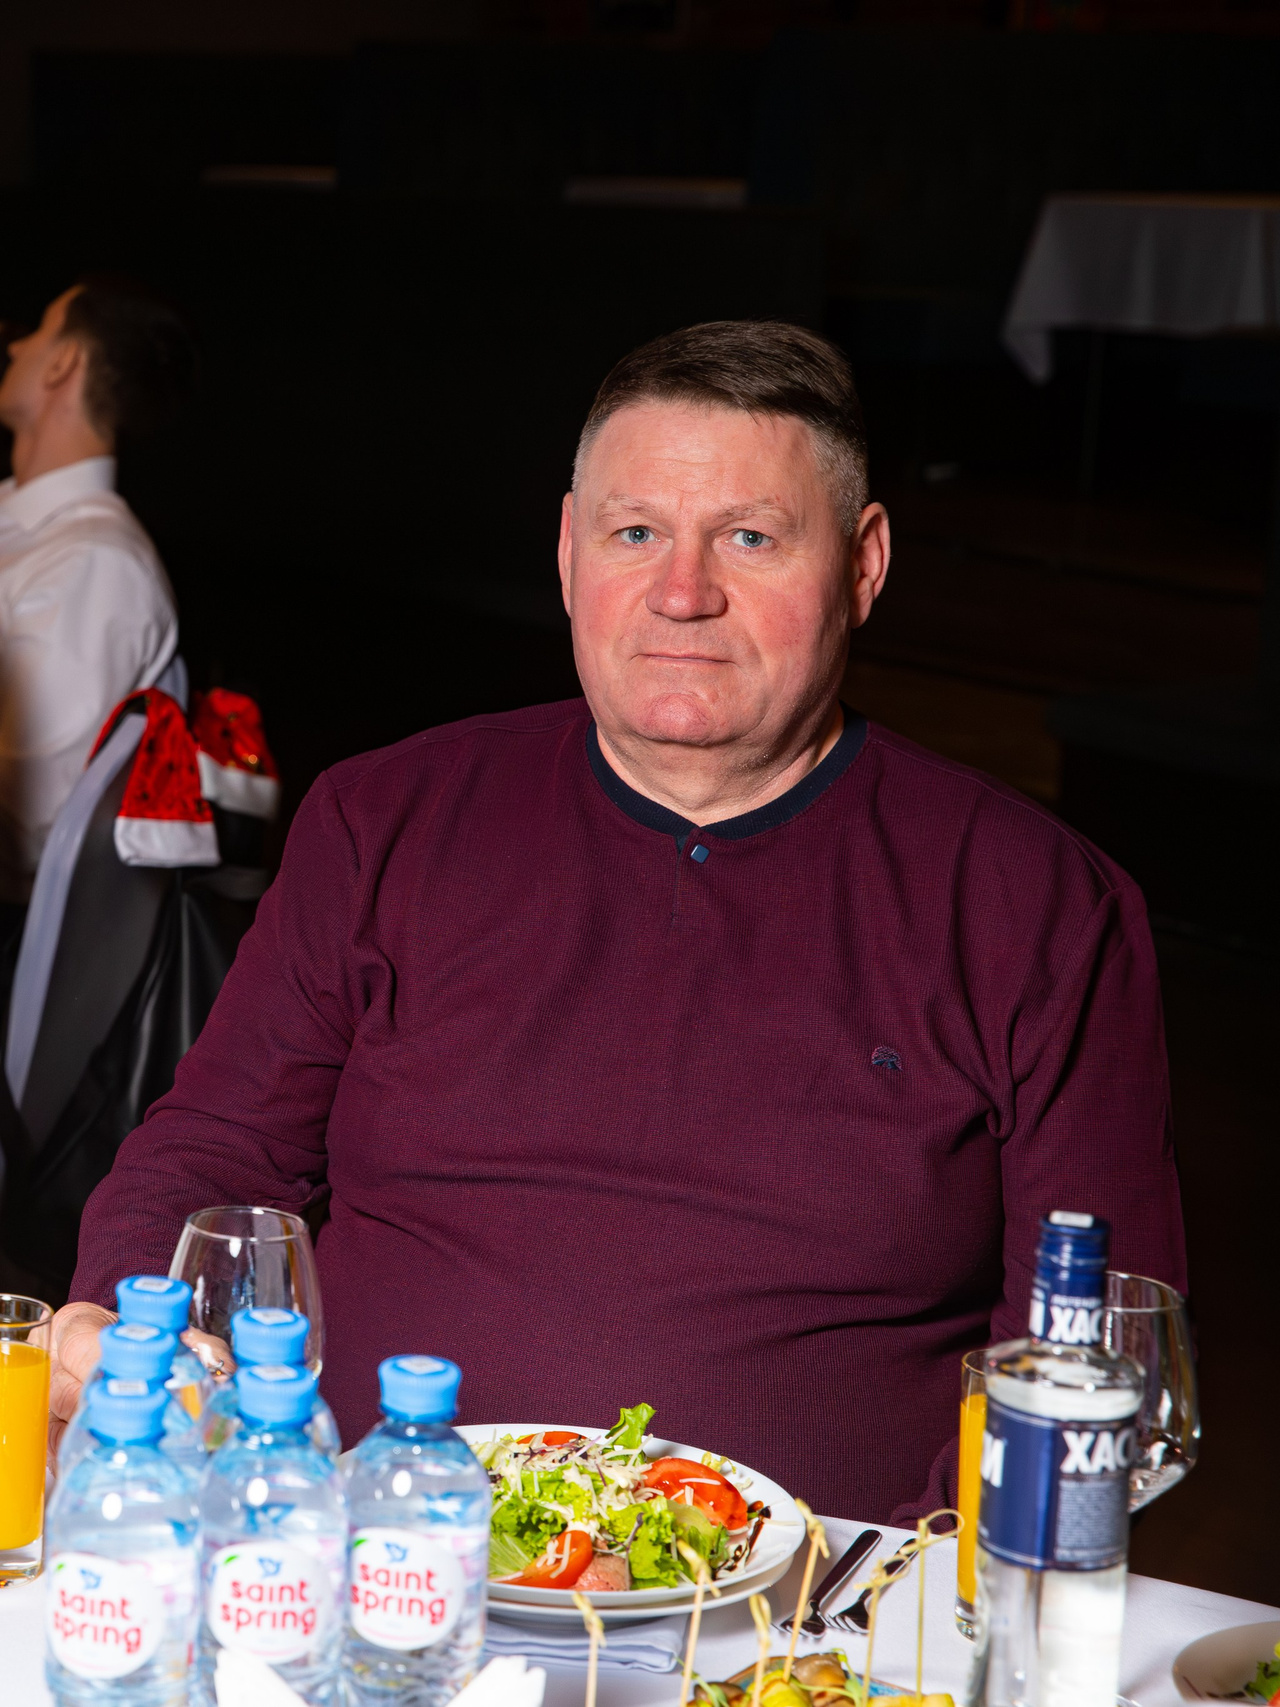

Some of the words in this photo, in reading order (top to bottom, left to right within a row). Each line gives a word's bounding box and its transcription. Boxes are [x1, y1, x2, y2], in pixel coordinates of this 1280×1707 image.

[230, 1577, 310, 1603] saint
[358, 1562, 438, 1593] saint
[59, 1588, 133, 1621] saint
[220, 1602, 317, 1637] spring
[350, 1583, 446, 1627] spring
[52, 1609, 142, 1656] spring
